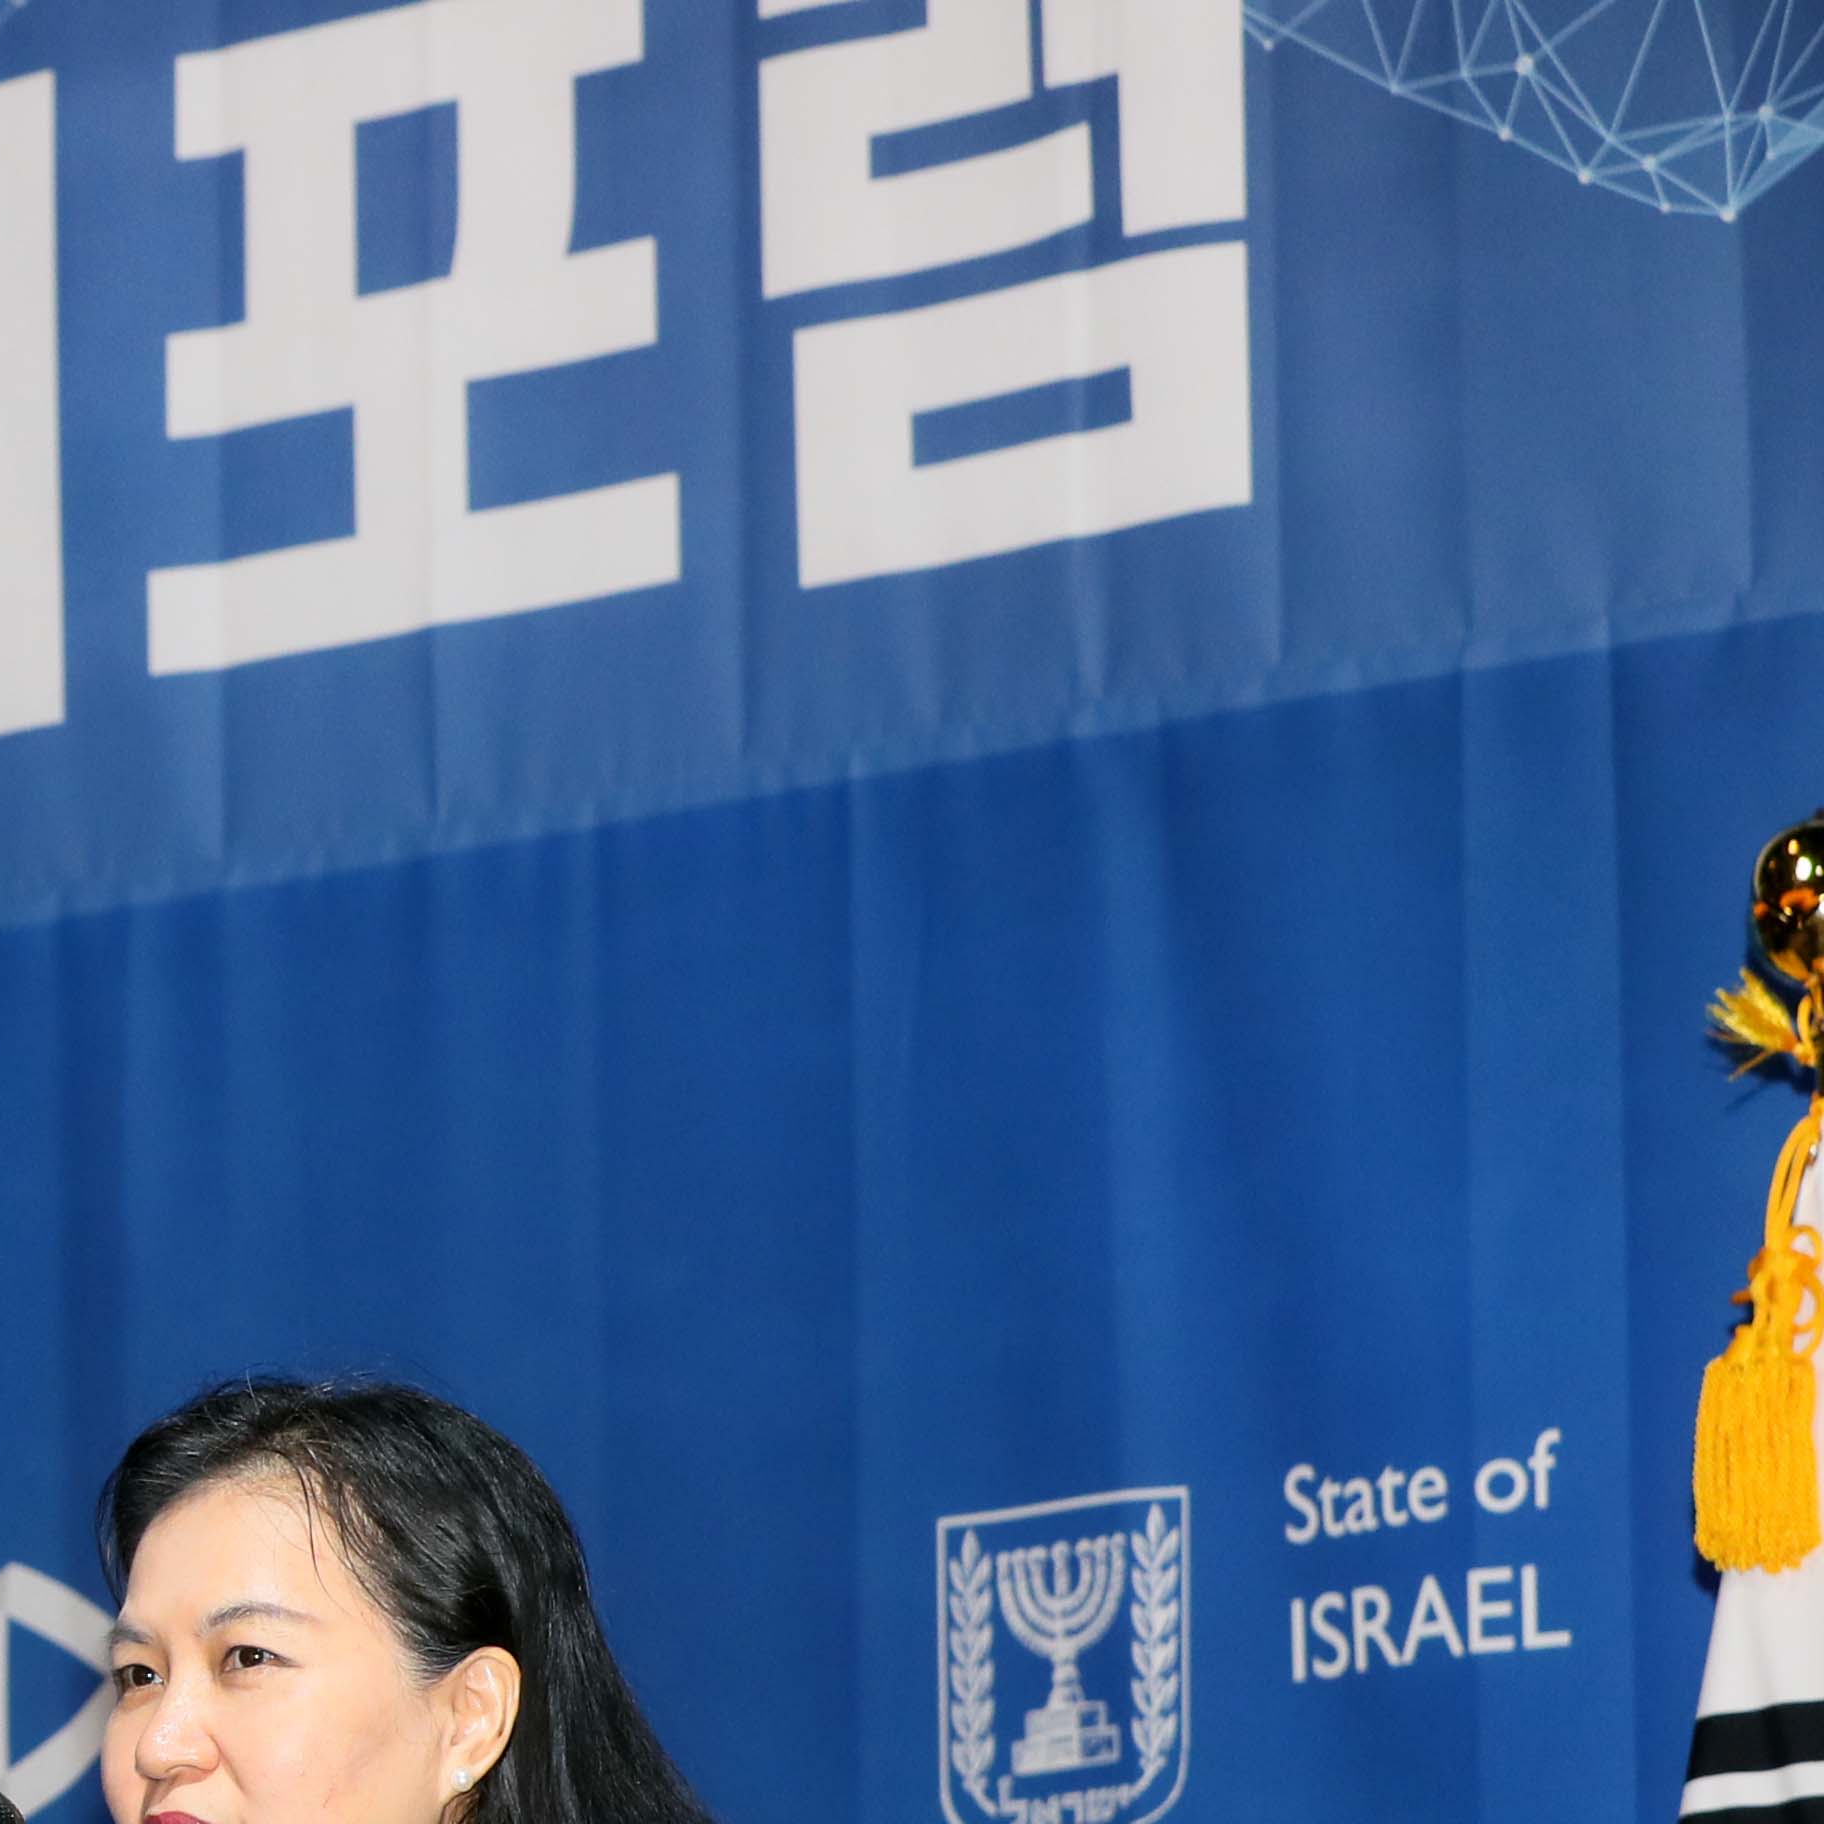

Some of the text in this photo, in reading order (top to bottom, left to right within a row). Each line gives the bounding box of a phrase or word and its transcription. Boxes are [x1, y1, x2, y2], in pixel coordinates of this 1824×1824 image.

[1283, 1426, 1561, 1545] State of
[1289, 1562, 1572, 1684] ISRAEL
